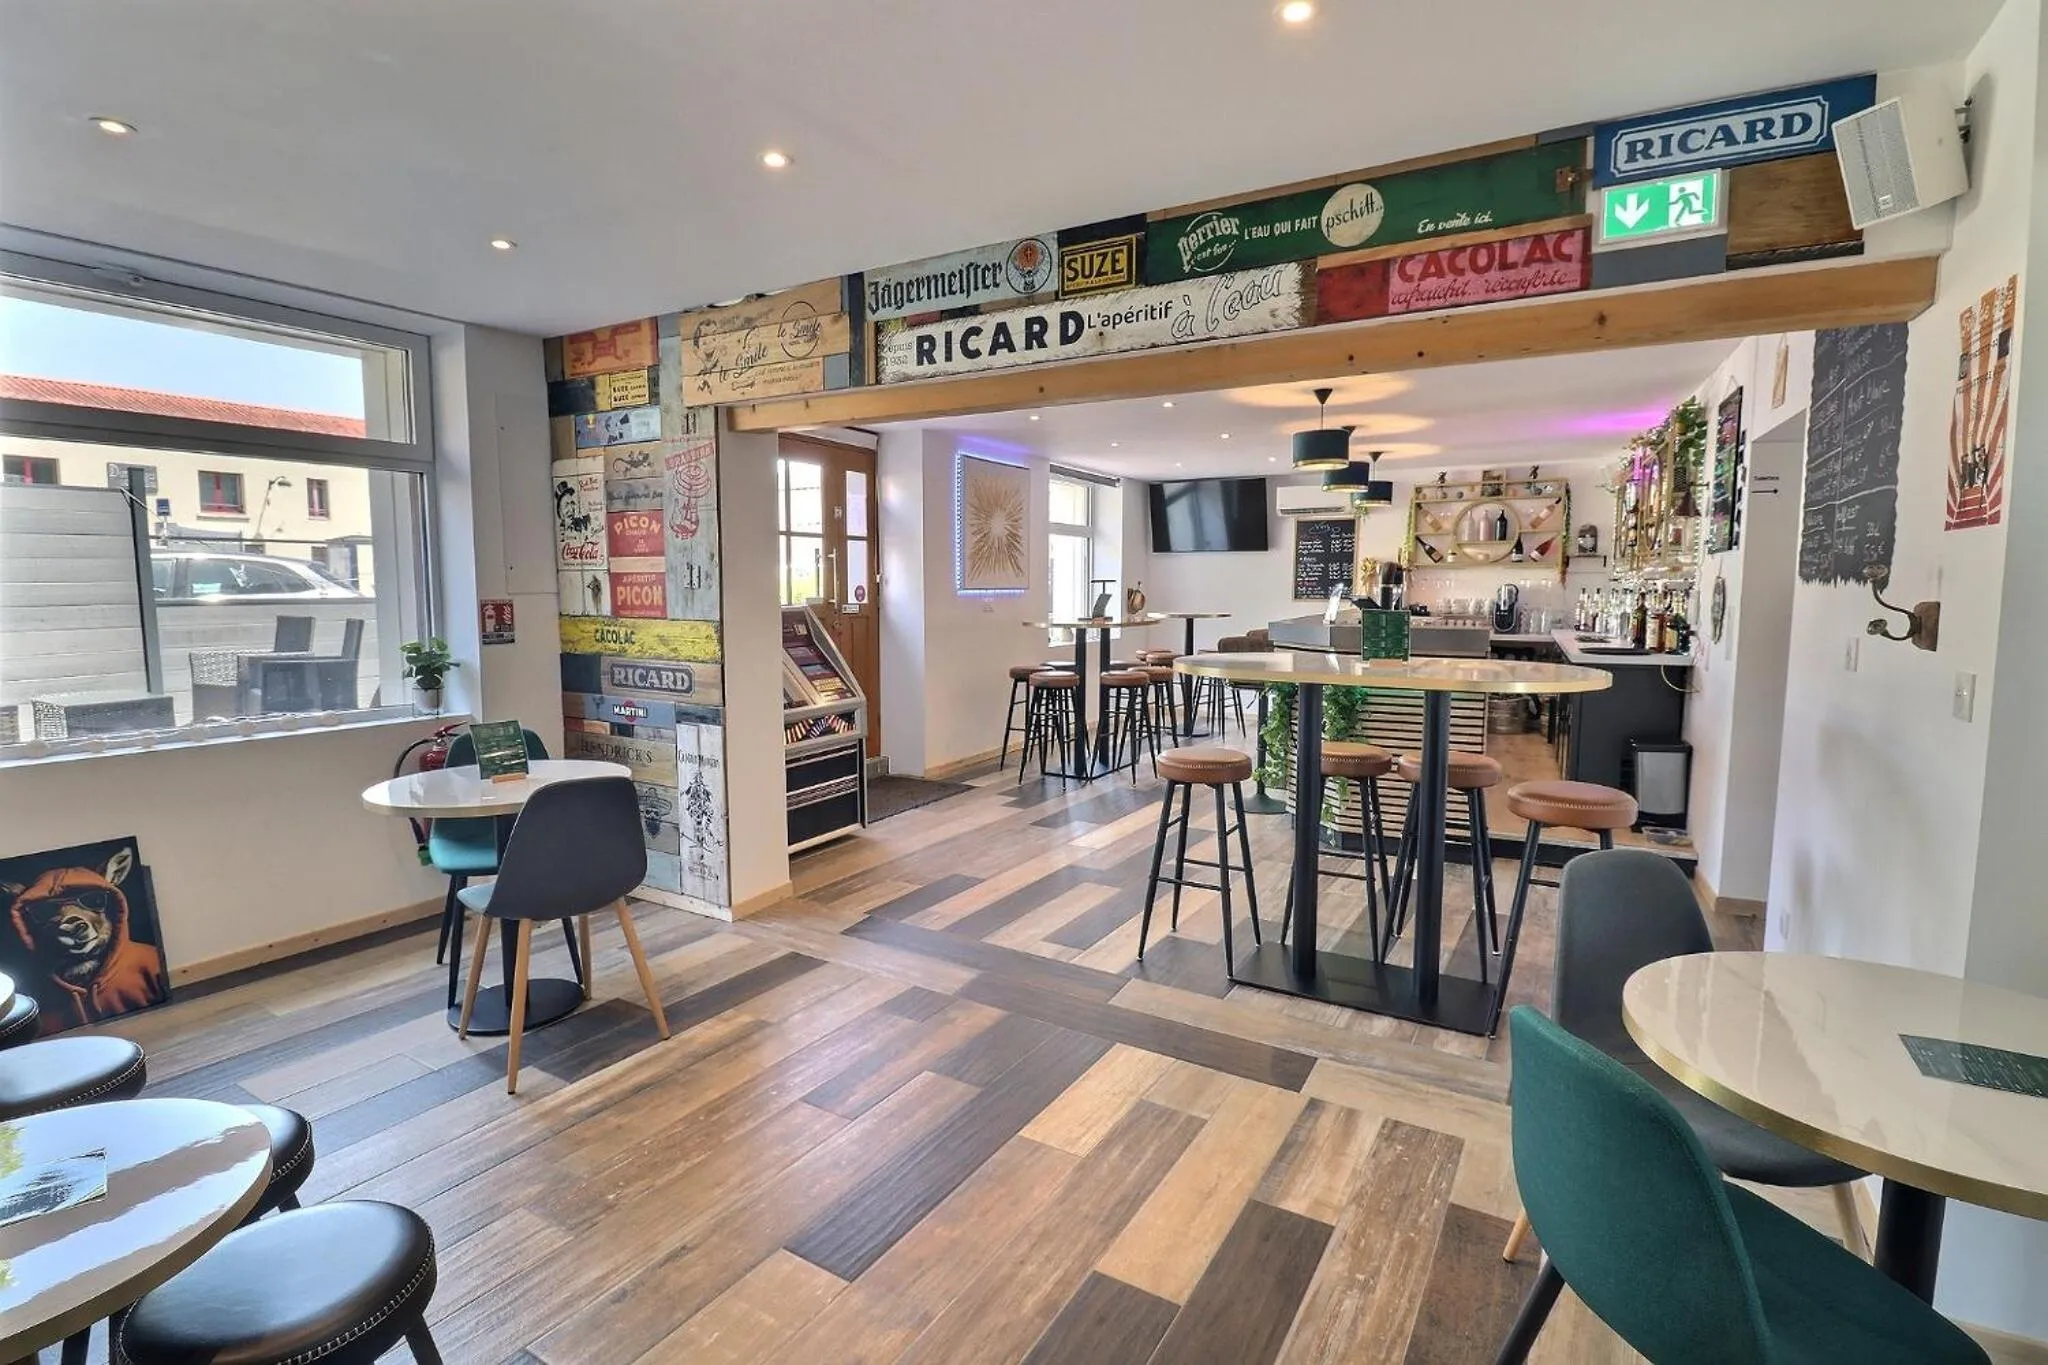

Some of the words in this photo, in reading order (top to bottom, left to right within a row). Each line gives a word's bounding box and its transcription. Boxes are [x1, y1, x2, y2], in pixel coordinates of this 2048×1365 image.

[1623, 111, 1814, 165] RICARD
[1244, 226, 1271, 240] L'EAU
[1274, 221, 1292, 235] QUI
[1295, 215, 1318, 231] FAIT
[1417, 218, 1435, 234] En
[1438, 212, 1471, 229] vente
[1066, 249, 1125, 282] SUZE
[1397, 232, 1576, 283] CACOLAC
[867, 260, 1002, 315] Jägermeister
[1087, 300, 1173, 331] L'apéritif
[1170, 294, 1195, 339] à
[1206, 270, 1283, 333] l'eau
[915, 311, 1085, 367] RICARD
[733, 342, 768, 379] Smile
[614, 515, 661, 535] PICON
[616, 585, 663, 607] PICON
[594, 628, 636, 645] CACOLAC
[612, 666, 691, 691] RICARD
[612, 705, 648, 719] MARTINI
[581, 738, 653, 764] HENDRICK'S
